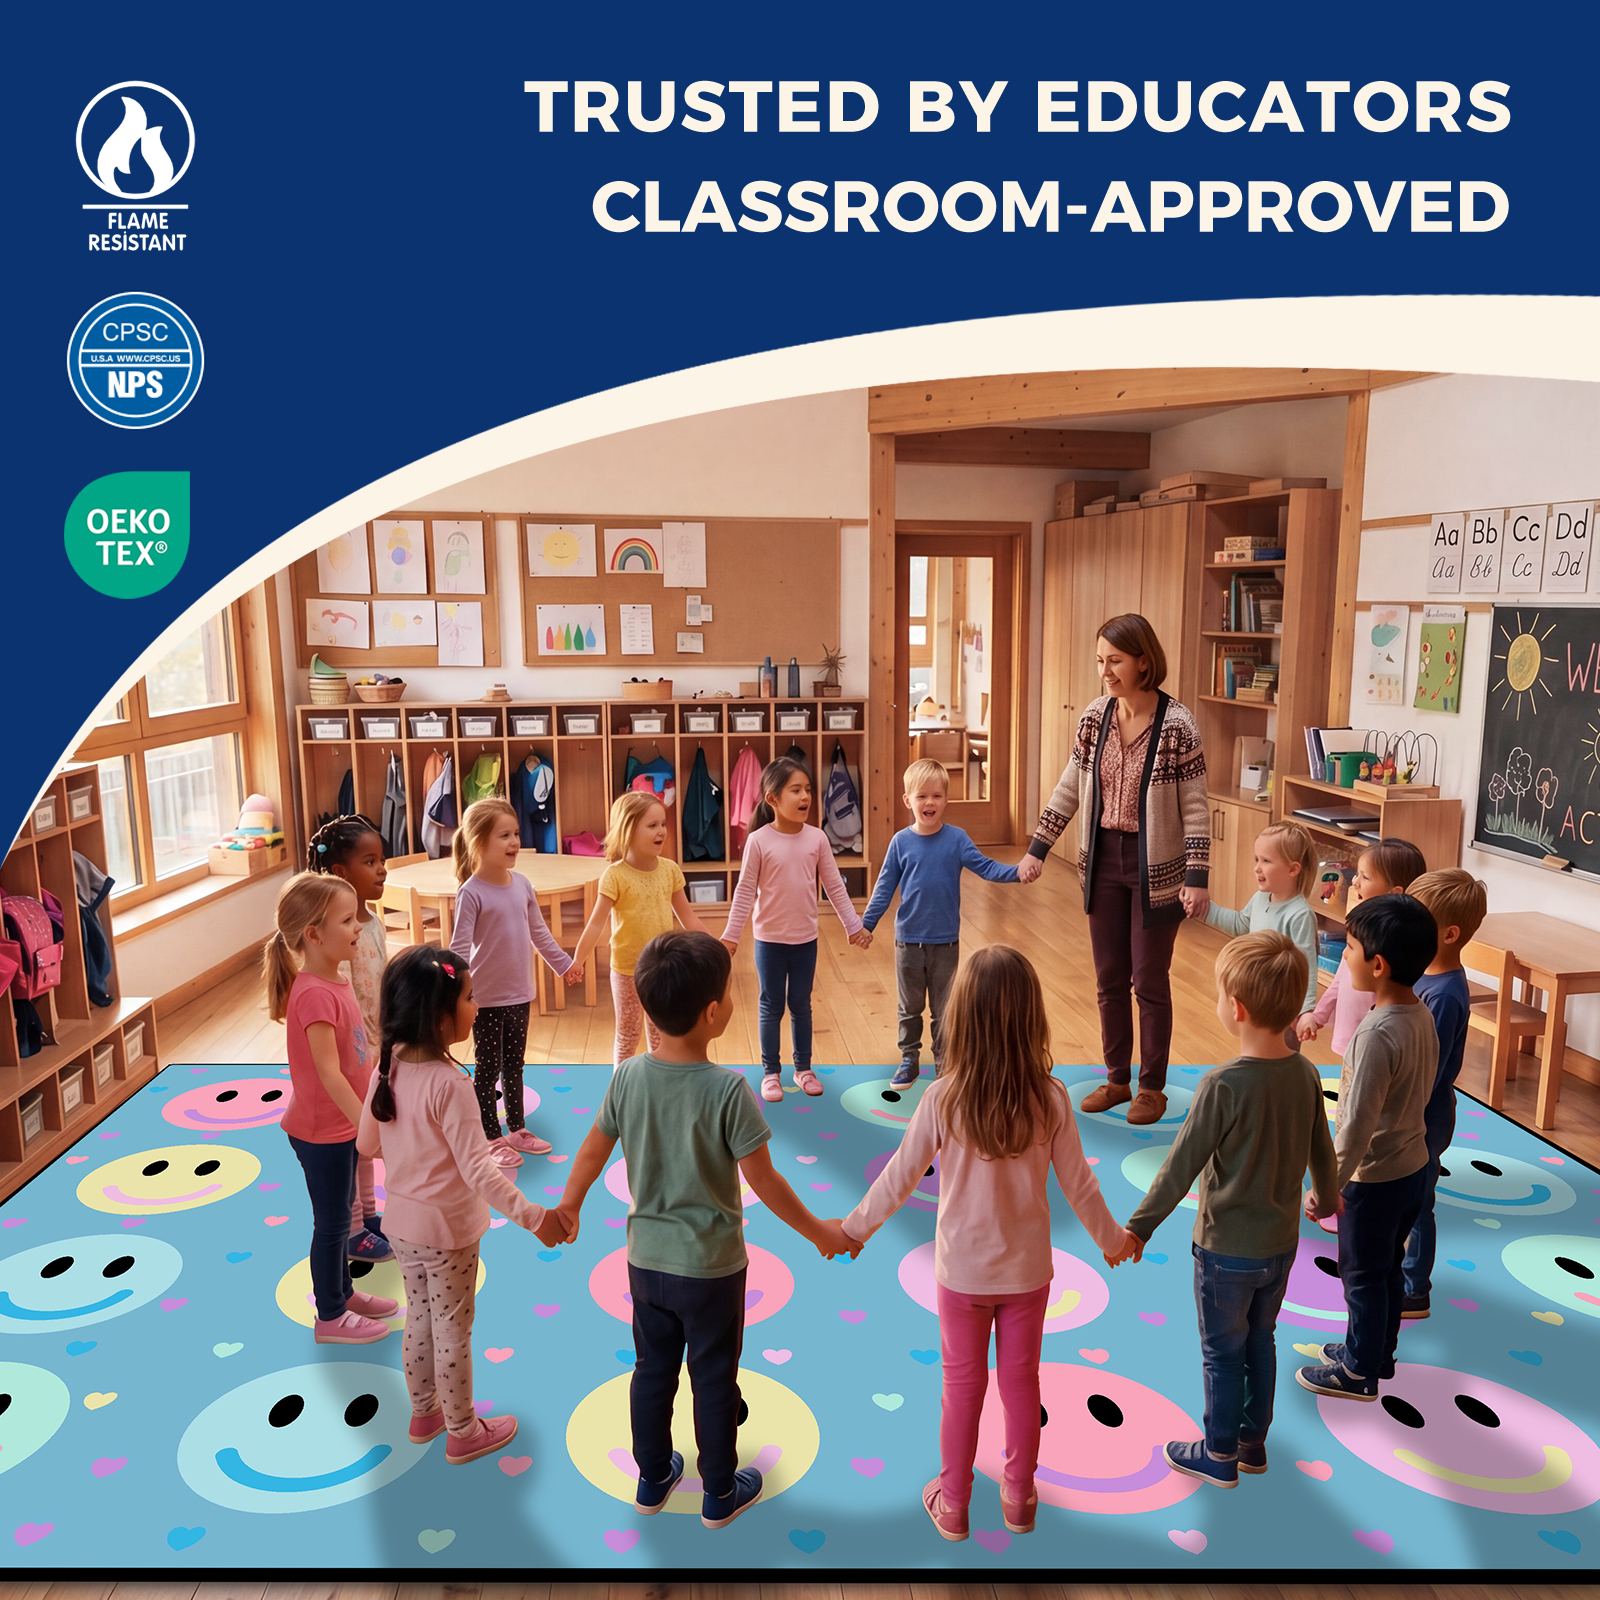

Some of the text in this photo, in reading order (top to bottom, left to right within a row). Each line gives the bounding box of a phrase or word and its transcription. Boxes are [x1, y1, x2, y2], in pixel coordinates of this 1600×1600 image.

[1434, 521, 1459, 547] Aa
[1472, 516, 1498, 545] Bb
[1513, 515, 1540, 541] Cc
[1556, 508, 1589, 540] Dd
[1512, 553, 1532, 577] Cc
[1551, 551, 1584, 577] Dd
[1559, 805, 1600, 845] AC
